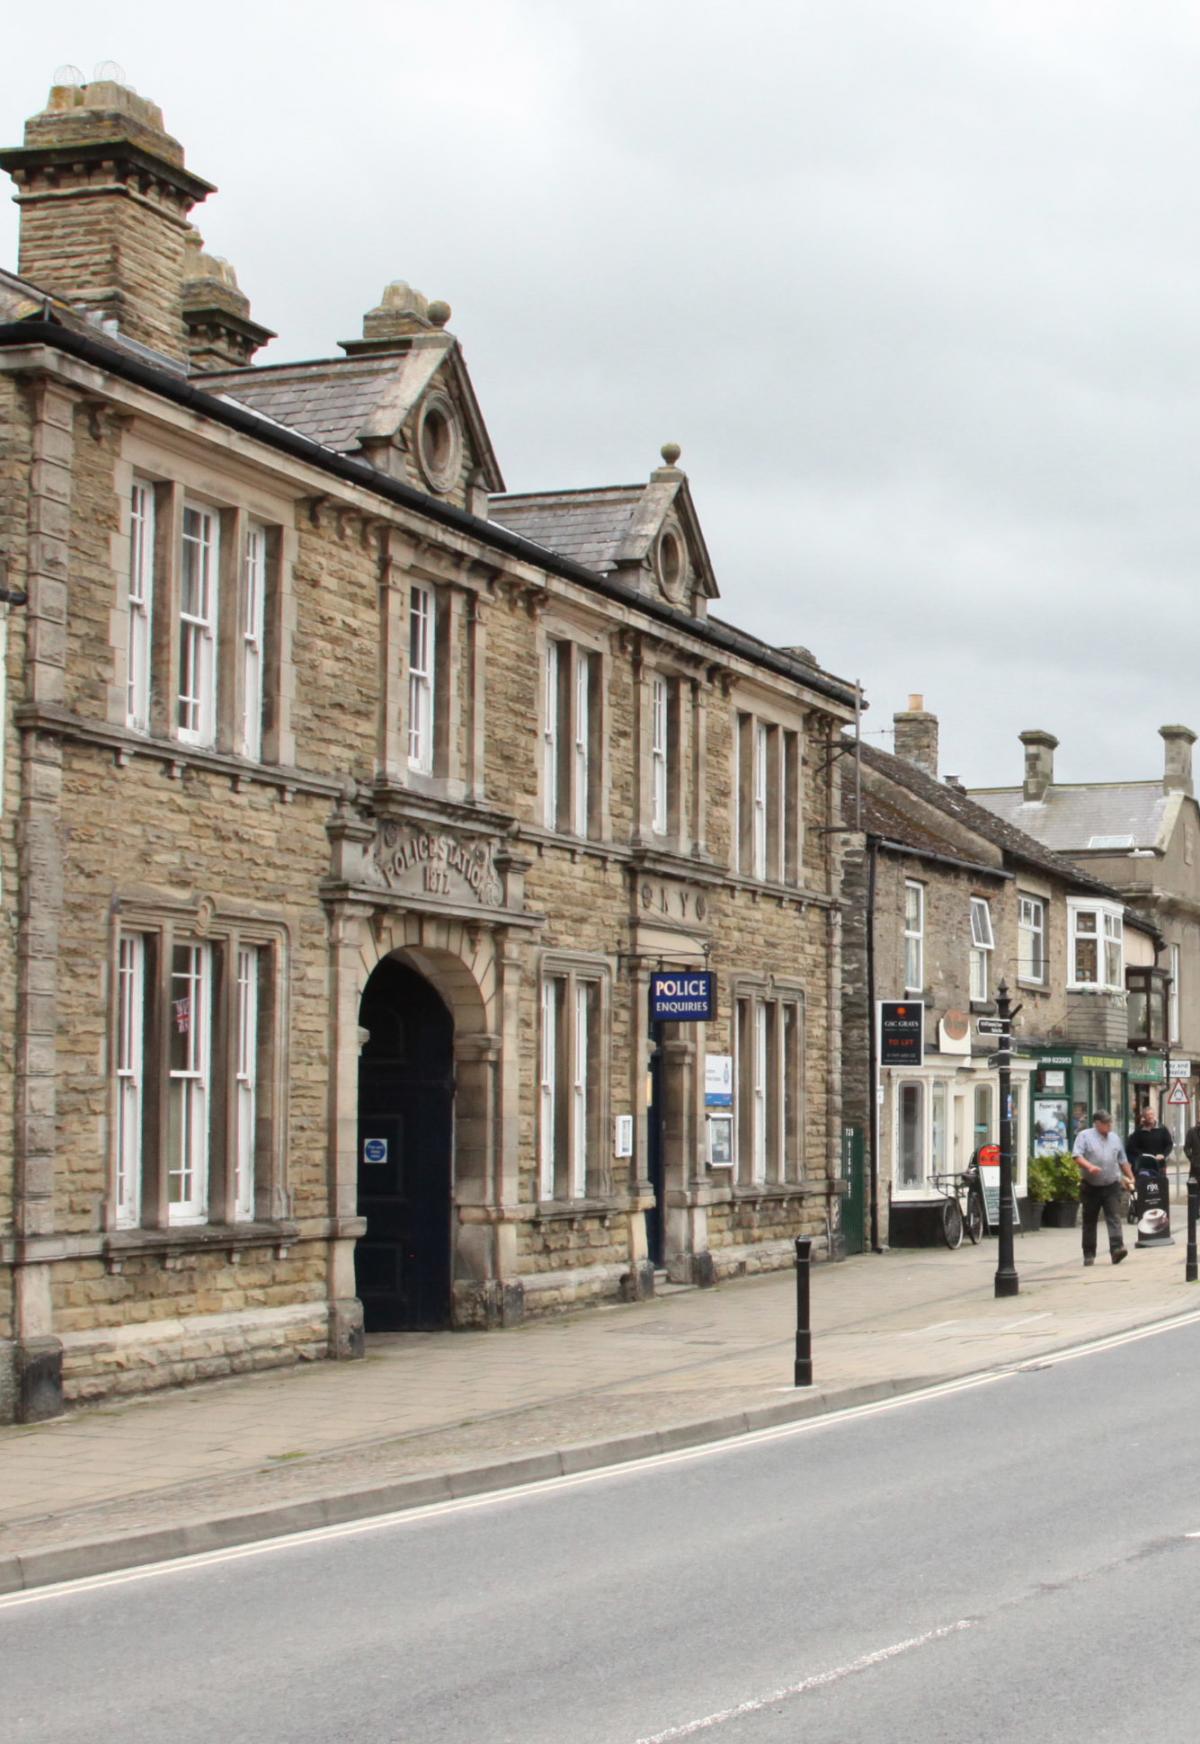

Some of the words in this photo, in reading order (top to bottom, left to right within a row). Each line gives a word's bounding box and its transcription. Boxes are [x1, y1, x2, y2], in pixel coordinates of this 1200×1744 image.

[382, 836, 440, 888] POLICE
[438, 835, 483, 903] STATION
[655, 980, 708, 997] POLICE
[655, 1001, 708, 1013] ENQUIRIES
